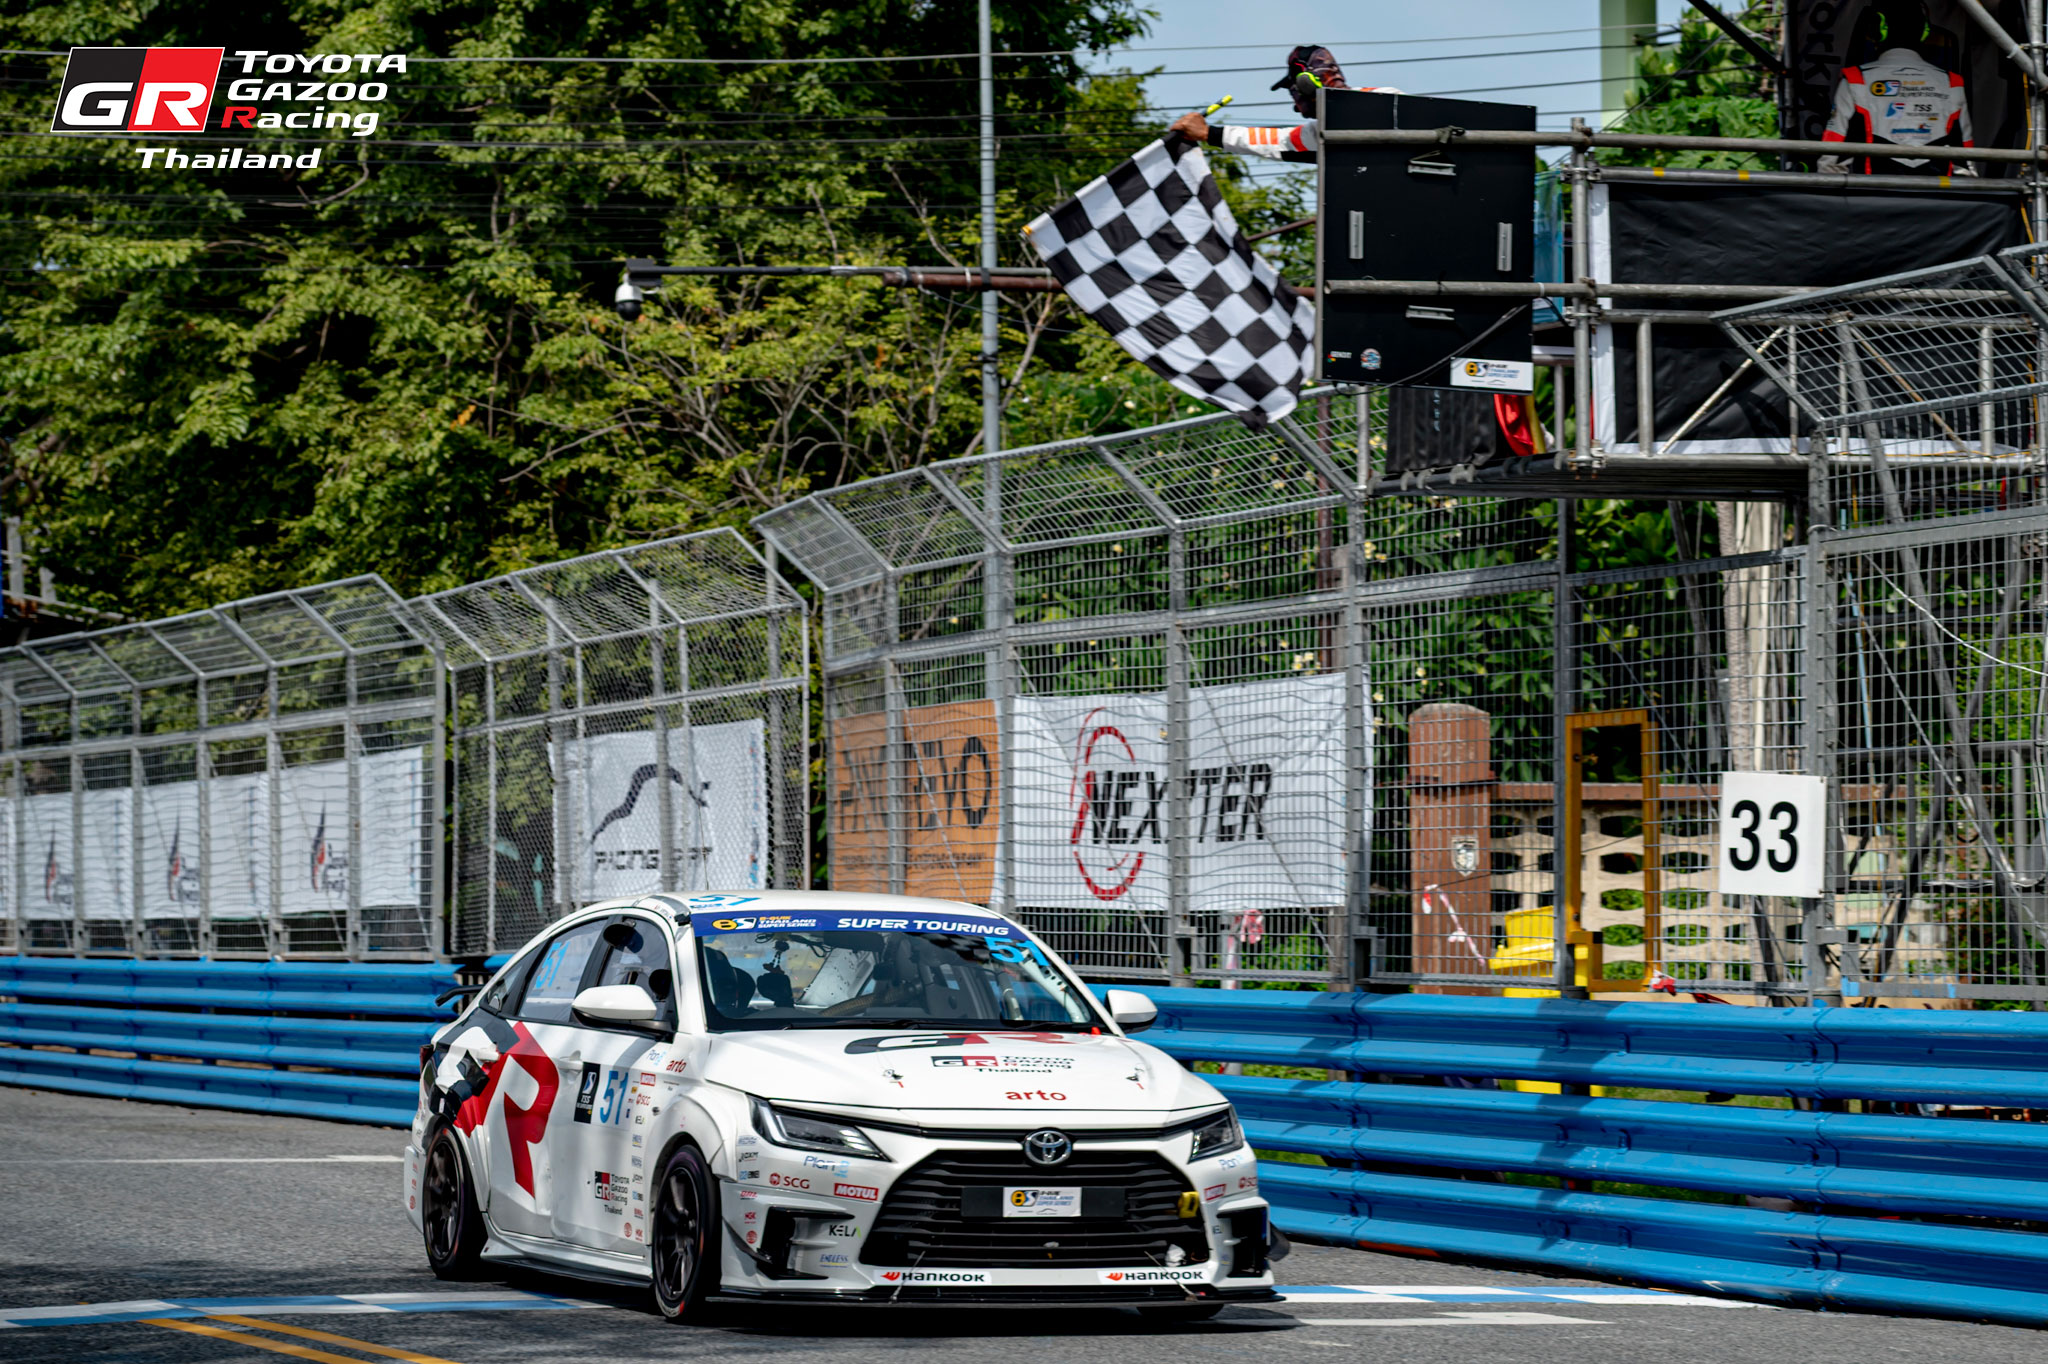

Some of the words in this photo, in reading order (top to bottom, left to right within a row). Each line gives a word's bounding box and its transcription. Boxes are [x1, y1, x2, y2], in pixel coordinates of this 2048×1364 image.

[1071, 763, 1273, 844] NEXTER
[1728, 799, 1799, 873] 33
[837, 917, 909, 930] SUPER
[913, 919, 1009, 936] TOURING
[983, 935, 1050, 967] 51
[535, 941, 570, 989] 51
[932, 1058, 999, 1067] GR
[599, 1070, 629, 1125] 51
[1004, 1089, 1067, 1101] arto
[594, 1182, 611, 1200] GR
[783, 1175, 811, 1190] SCG
[835, 1184, 877, 1199] MOTUL
[819, 1254, 849, 1264] ENDLESS
